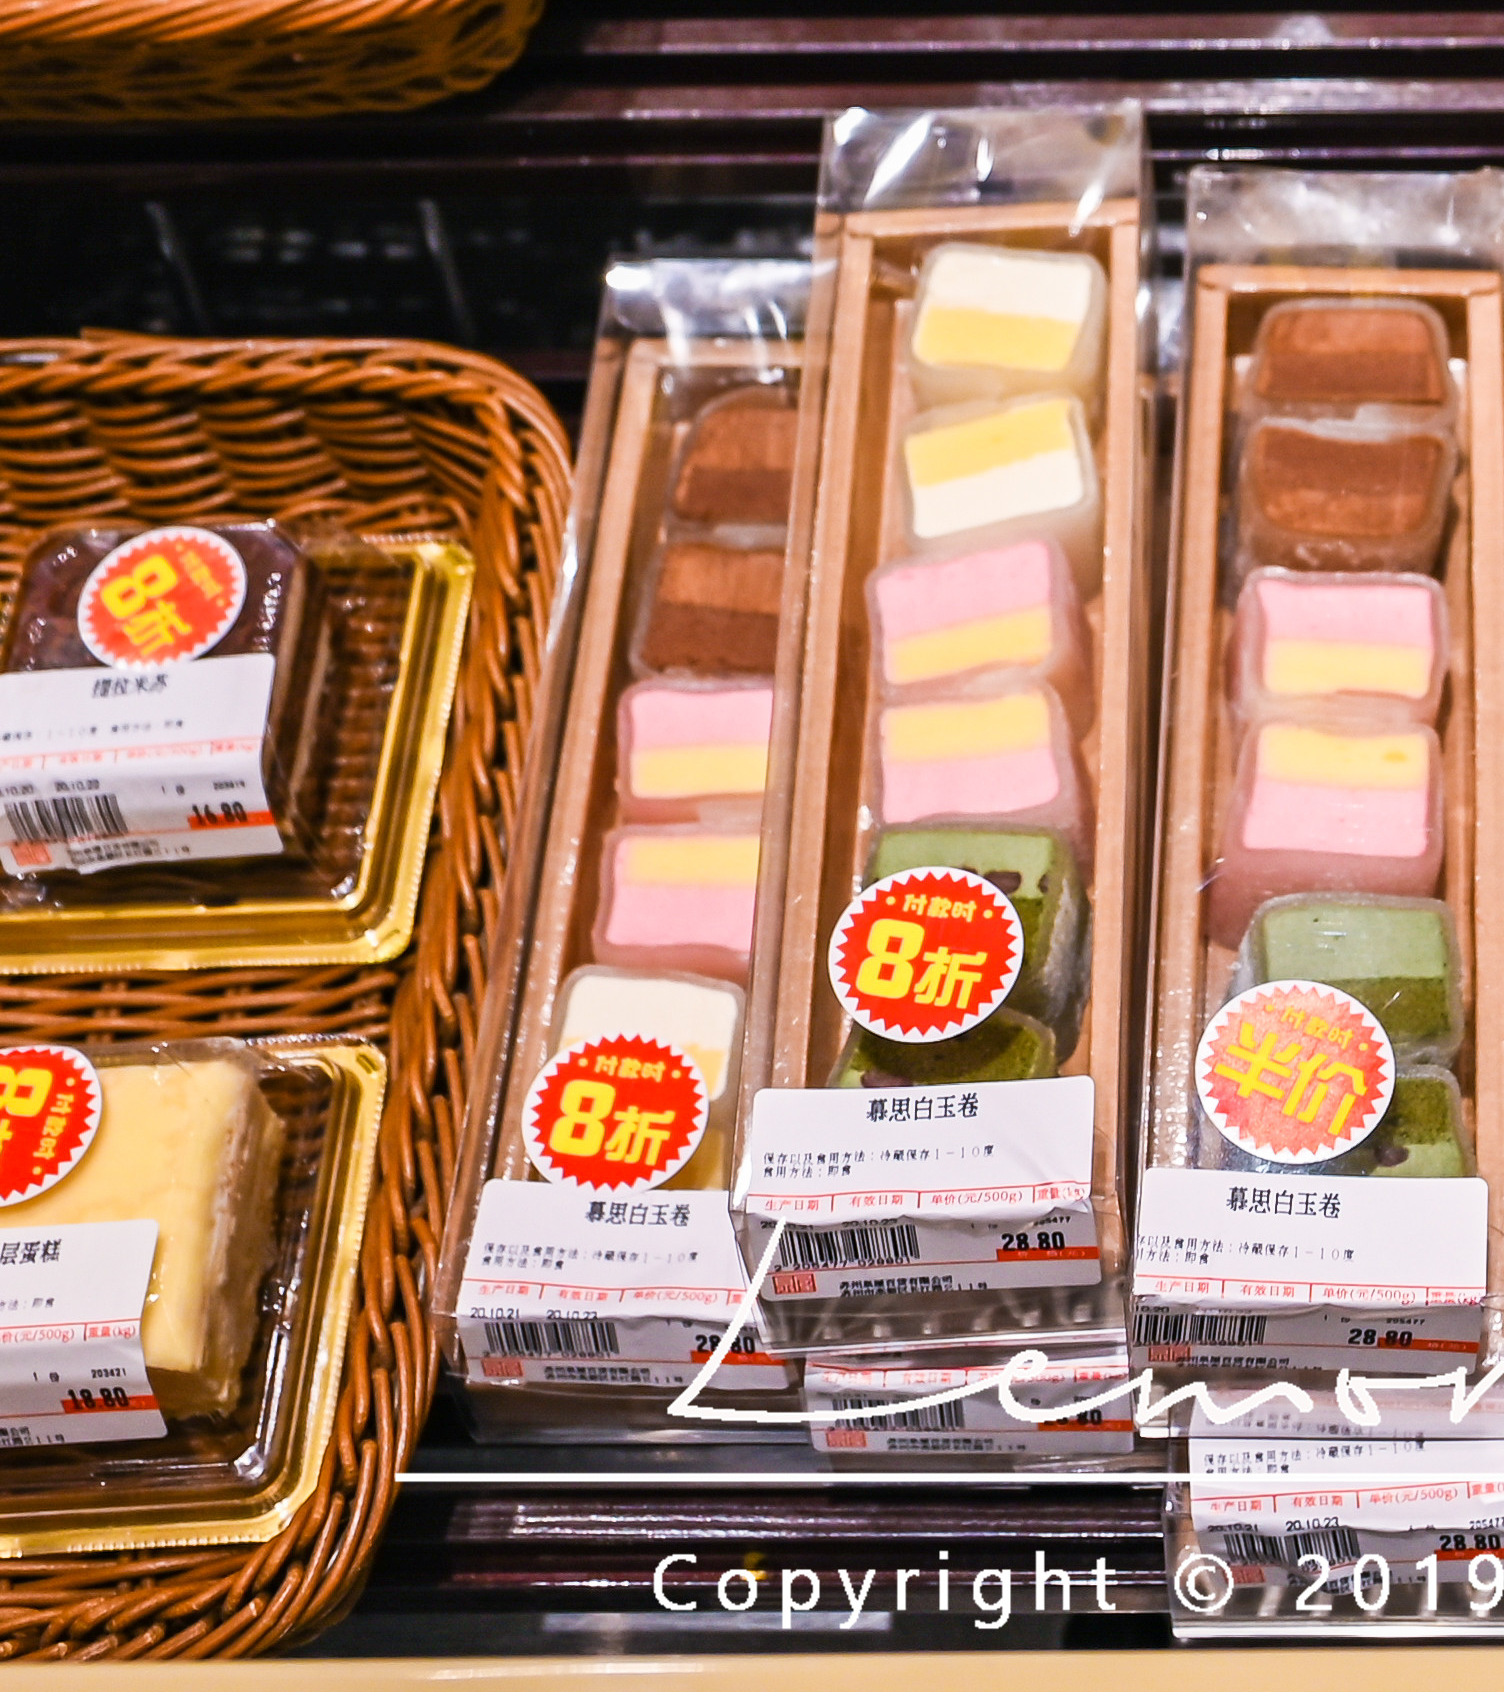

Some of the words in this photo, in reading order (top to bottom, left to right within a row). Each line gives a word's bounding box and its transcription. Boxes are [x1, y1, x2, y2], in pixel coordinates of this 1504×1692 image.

[100, 554, 193, 657] 8折
[902, 893, 978, 922] 付款时
[854, 917, 988, 1010] 8折
[1278, 1007, 1354, 1052] 付款时
[594, 1054, 667, 1084] 付款时
[1213, 1022, 1368, 1137] 半价
[866, 1091, 979, 1123] 慕思白玉卷
[548, 1078, 677, 1167] 8折
[585, 1200, 691, 1230] 慕思白玉卷
[764, 1199, 819, 1212] 生产日期
[848, 1195, 904, 1208] 有效日期
[930, 1190, 1024, 1205] 单价(元/500g)
[1225, 1186, 1341, 1219] 慕思白玉卷
[1000, 1230, 1066, 1251] 28.80
[1154, 1280, 1210, 1295] 生产日期
[1239, 1283, 1295, 1299] 有效日期
[1321, 1286, 1417, 1303] 单价(元/500g)
[1291, 1494, 1344, 1508] 有效日期
[1285, 1516, 1340, 1533] 20.10.23
